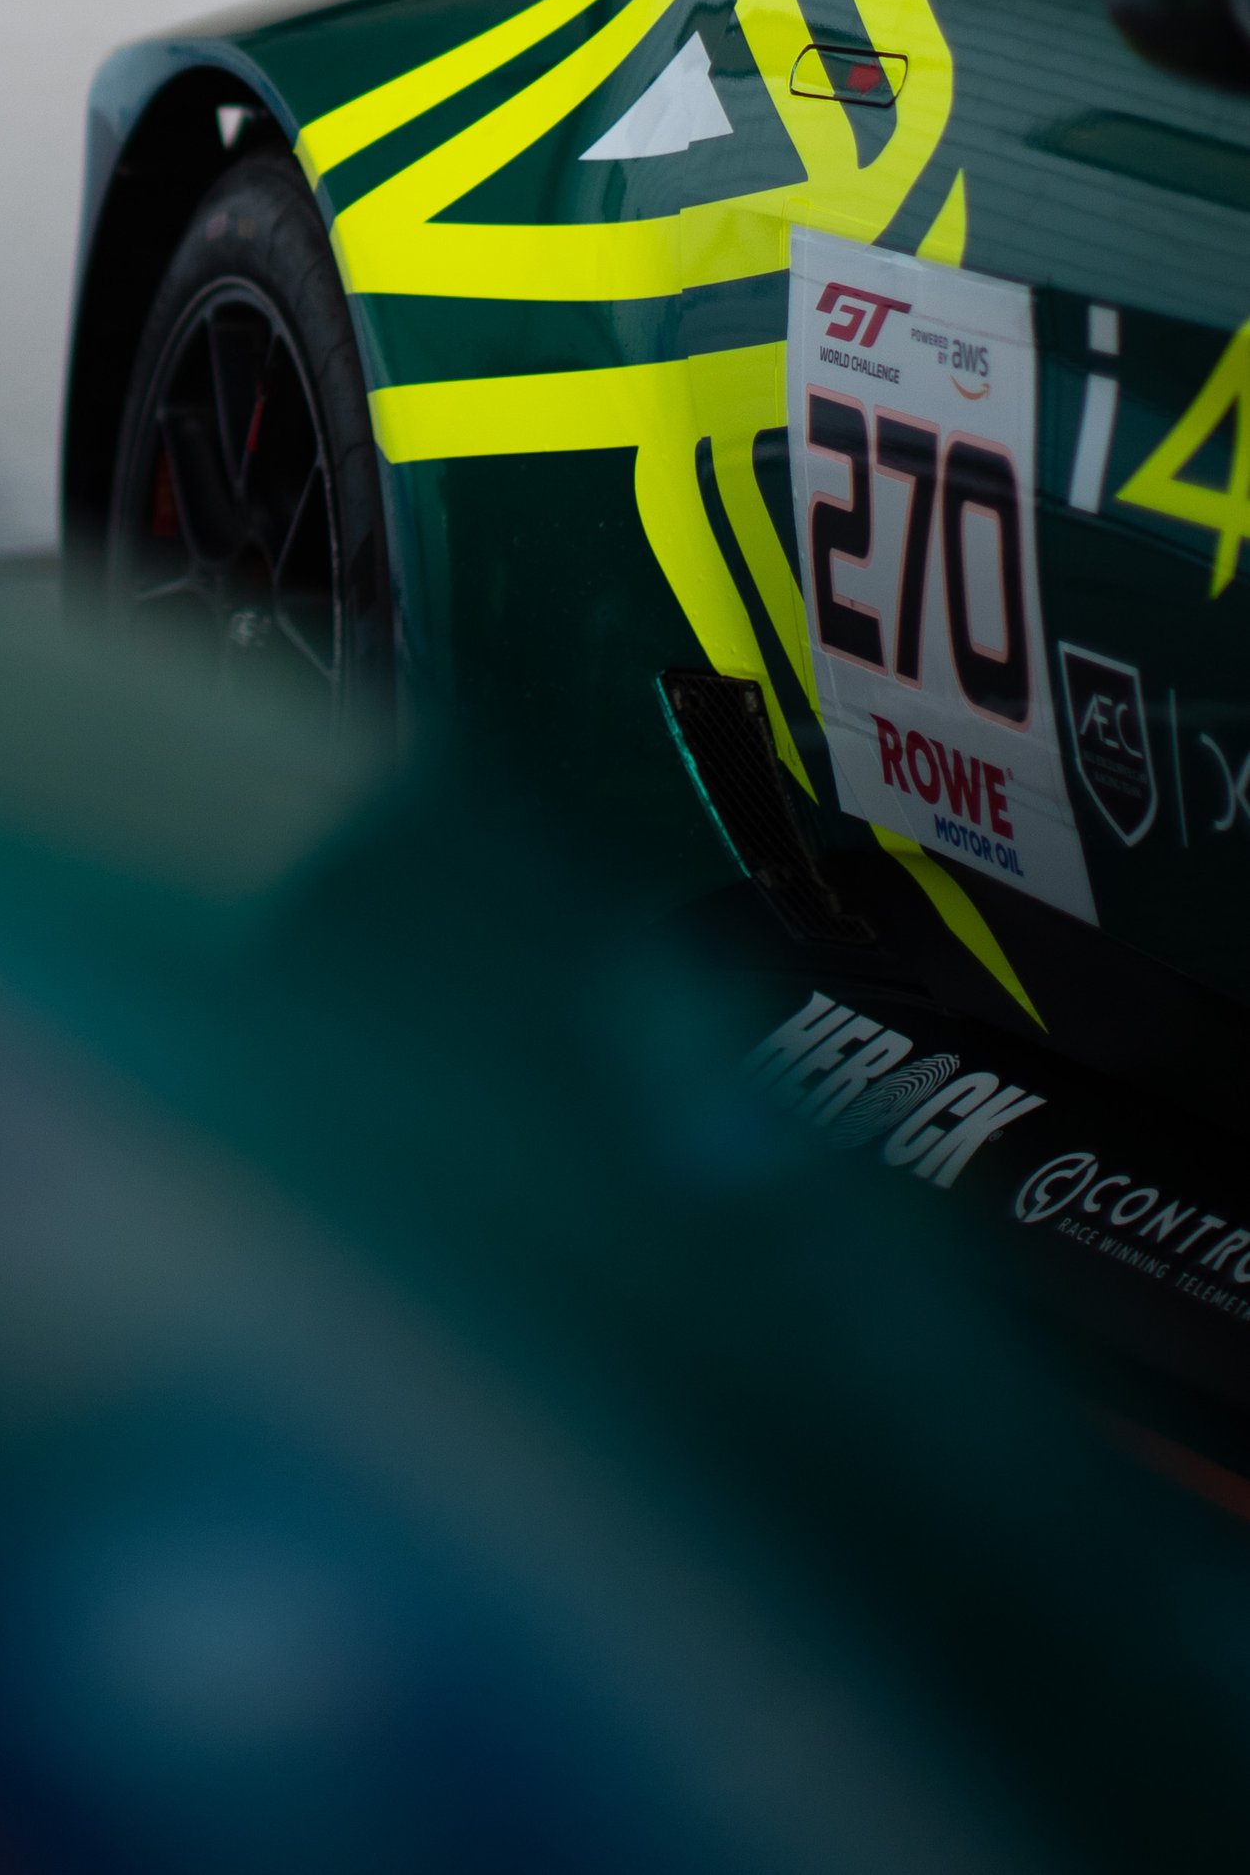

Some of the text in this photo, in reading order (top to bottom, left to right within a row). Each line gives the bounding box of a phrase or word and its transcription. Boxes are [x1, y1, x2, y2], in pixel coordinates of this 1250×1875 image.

[815, 282, 912, 348] GT
[911, 328, 949, 350] POWERED
[819, 345, 900, 384] WORLD CHALLENGE
[937, 351, 949, 365] BY
[952, 338, 990, 378] aws
[806, 383, 1032, 733] 270
[870, 713, 1015, 841] ROWE
[934, 813, 1025, 877] MOTOR OIL
[1057, 1217, 1097, 1246] RACE
[1099, 1235, 1171, 1280] WINNING
